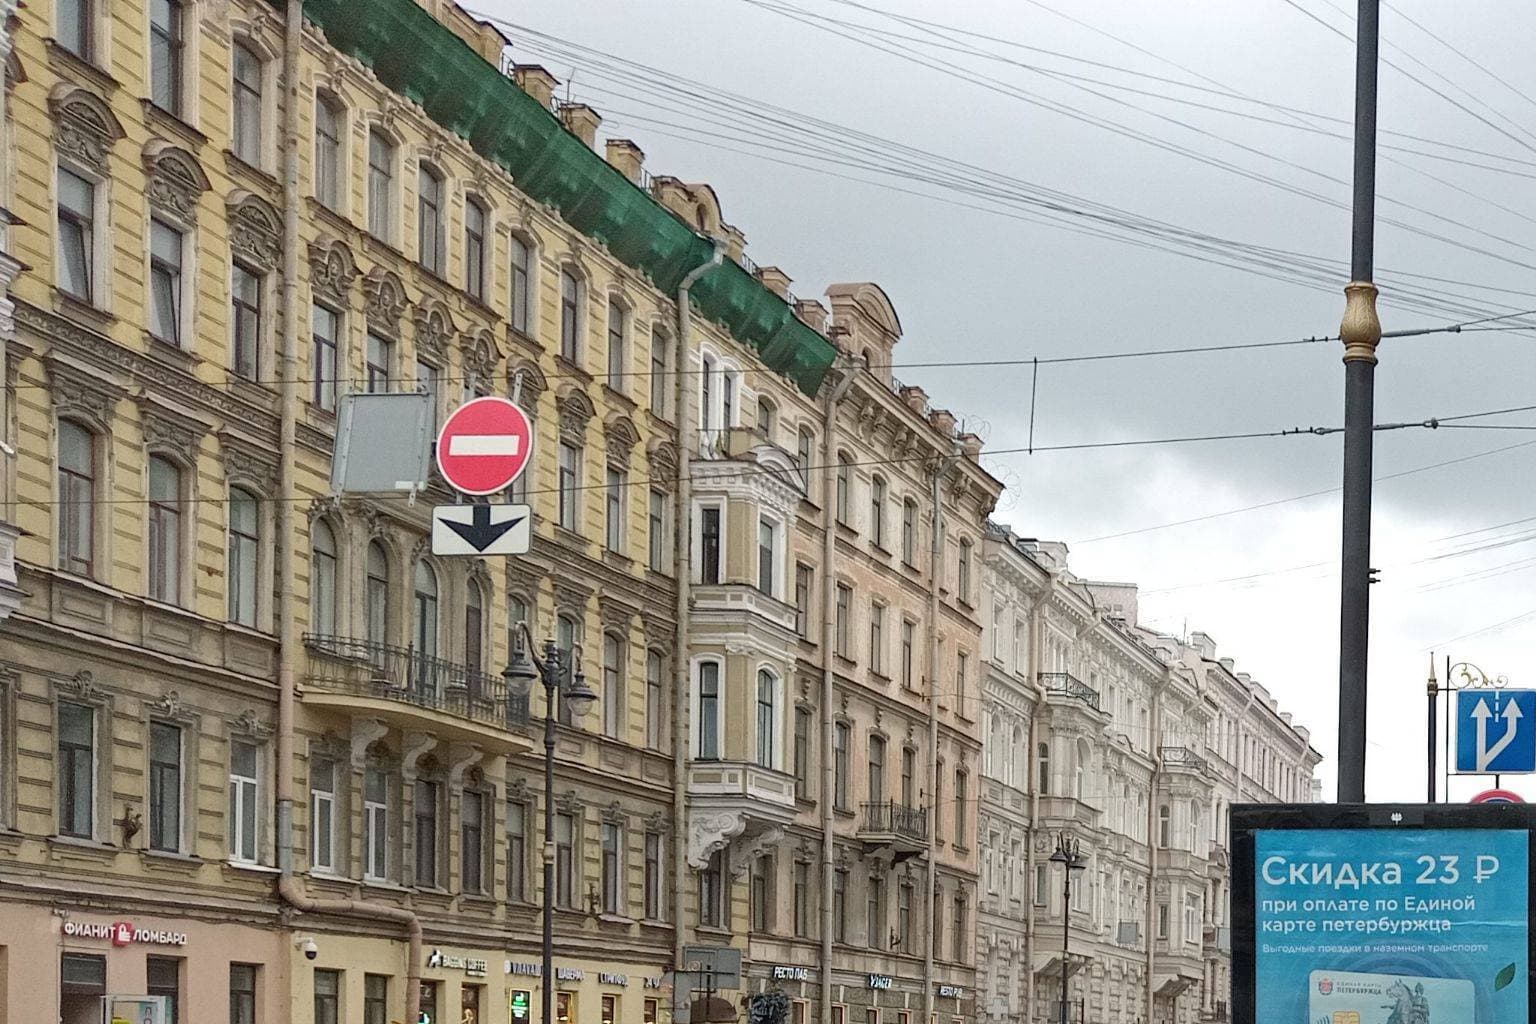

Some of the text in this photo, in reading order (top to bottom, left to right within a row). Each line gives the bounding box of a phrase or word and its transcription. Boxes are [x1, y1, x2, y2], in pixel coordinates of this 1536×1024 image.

[1262, 856, 1402, 890] Скидка
[1416, 855, 1460, 884] 23
[1262, 895, 1476, 914] при оплате по Единой
[64, 922, 187, 945] ФИАНИТ ЛОМБАРД
[1262, 917, 1451, 934] карте петербуржца
[1262, 944, 1315, 953] Выгодные
[1318, 945, 1361, 953] поездки
[1428, 944, 1488, 953] транспорте
[774, 966, 808, 981] РЕСТО ПАБ
